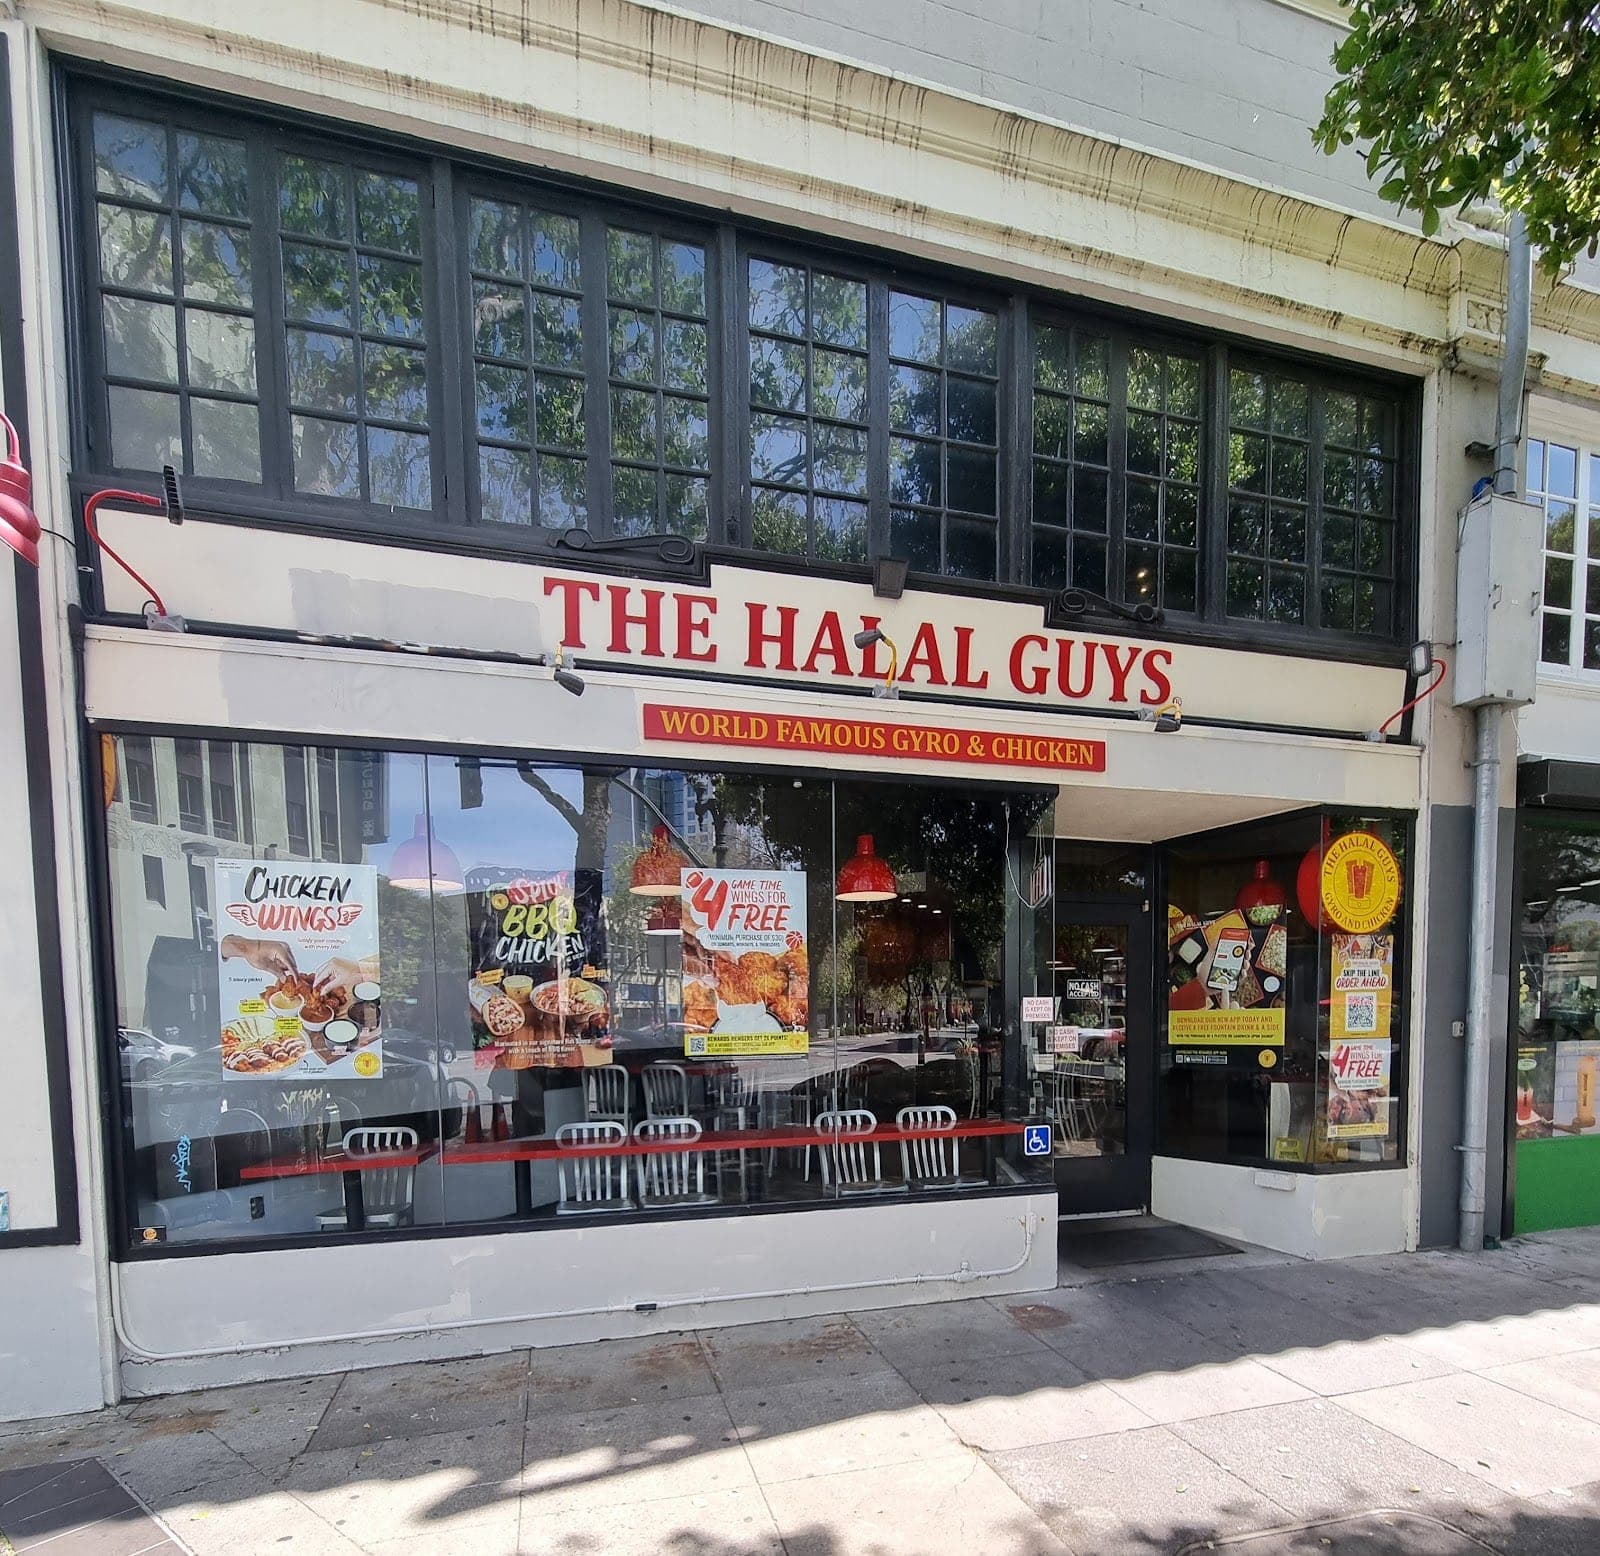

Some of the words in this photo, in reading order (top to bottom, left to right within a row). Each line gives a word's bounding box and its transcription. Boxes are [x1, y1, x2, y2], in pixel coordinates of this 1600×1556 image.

[543, 577, 717, 662] THE
[744, 602, 988, 689] HALAL
[1009, 634, 1172, 705] GUYS
[660, 710, 768, 739] WORLD
[776, 719, 886, 749] FAMOUS
[892, 729, 960, 755] GYRO
[967, 736, 985, 756] &
[992, 738, 1094, 765] CHICKEN
[1324, 849, 1338, 876] THE
[1339, 836, 1375, 852] HALAL
[1377, 848, 1395, 882] GUYS
[244, 866, 352, 903] CHICKEN
[731, 880, 755, 890] GAME
[760, 880, 782, 890] TIME
[732, 891, 764, 903] WINGS
[767, 891, 786, 903] FOR
[257, 904, 338, 932] WINGS
[502, 894, 580, 939] BBQ
[692, 878, 728, 931] 4
[728, 904, 791, 931] FREE
[1325, 892, 1342, 919] GYRO
[1343, 916, 1360, 929] AND
[1362, 896, 1395, 929] CHICKEN
[495, 934, 584, 962] CHICKEN
[1069, 982, 1080, 990] NO
[1081, 981, 1099, 992] CASH
[1336, 977, 1359, 988] ORDER
[1361, 976, 1387, 987] AHEAD
[1343, 969, 1355, 977] SKIP
[1357, 969, 1366, 977] THE
[1368, 969, 1380, 977] LINE
[1068, 1034, 1077, 1042] ON
[1332, 1045, 1350, 1077] 4
[1348, 1059, 1383, 1078] FREE
[1350, 1051, 1369, 1060] WINGS
